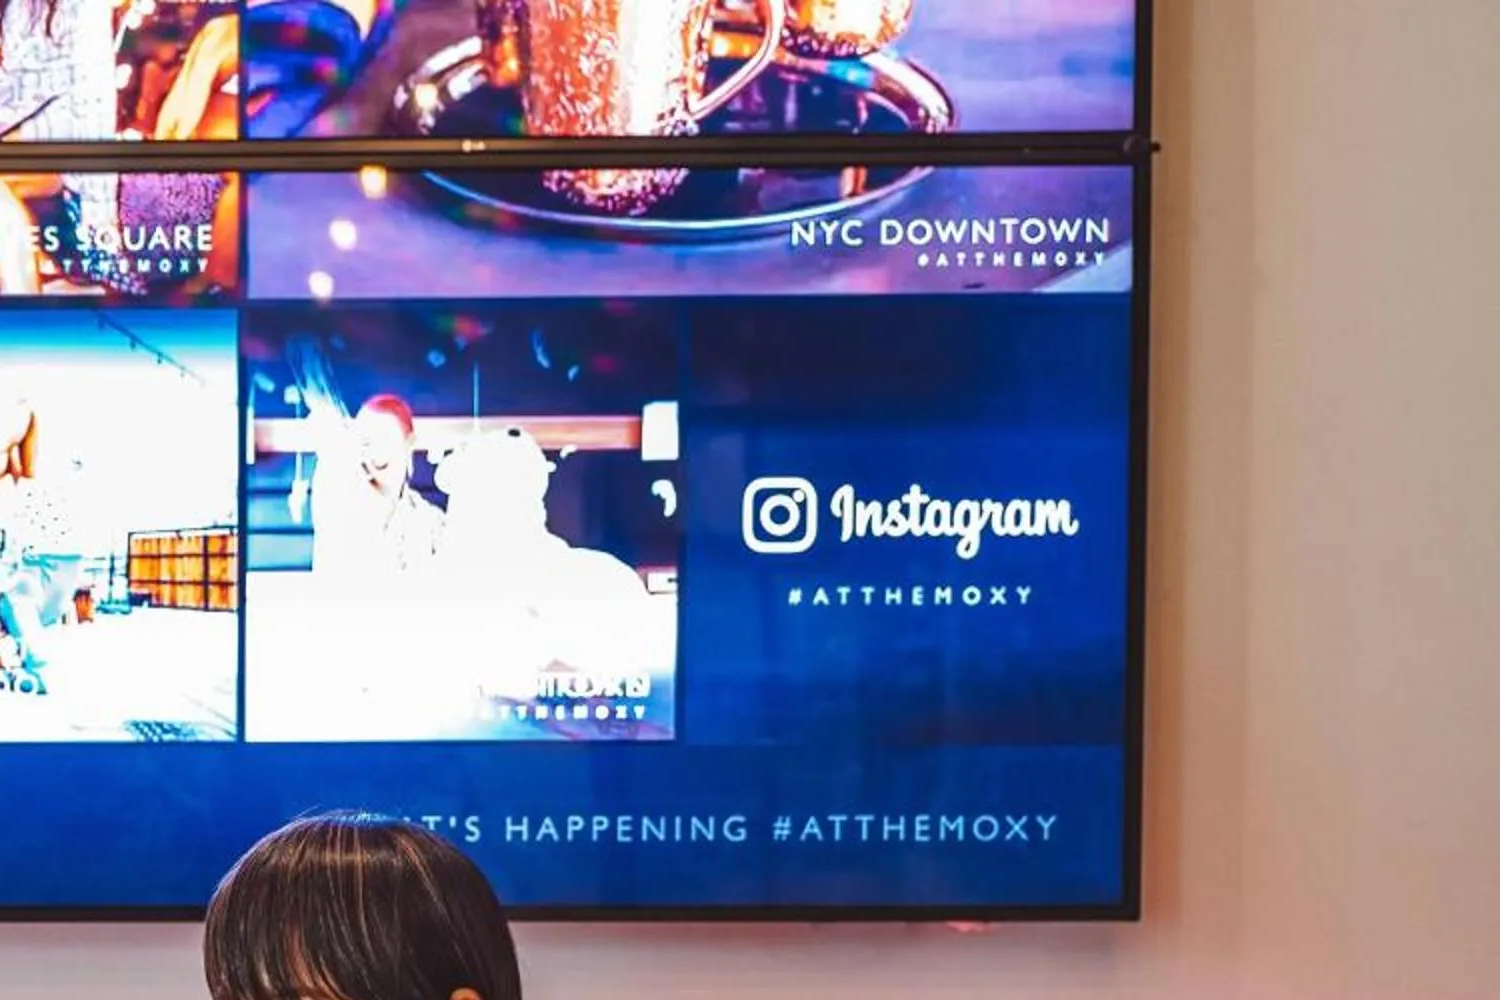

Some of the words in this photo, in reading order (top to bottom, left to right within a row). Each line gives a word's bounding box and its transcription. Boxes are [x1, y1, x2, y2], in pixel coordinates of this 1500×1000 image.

[75, 224, 213, 253] SQUARE
[791, 219, 863, 247] NYC
[880, 217, 1109, 246] DOWNTOWN
[40, 258, 209, 273] TTHEMOXY
[830, 483, 1080, 560] Instagram
[788, 585, 1032, 606] #ATTHEMOXY
[506, 814, 749, 842] HAPPENING
[771, 813, 1059, 842] #ATTHEMOXY
